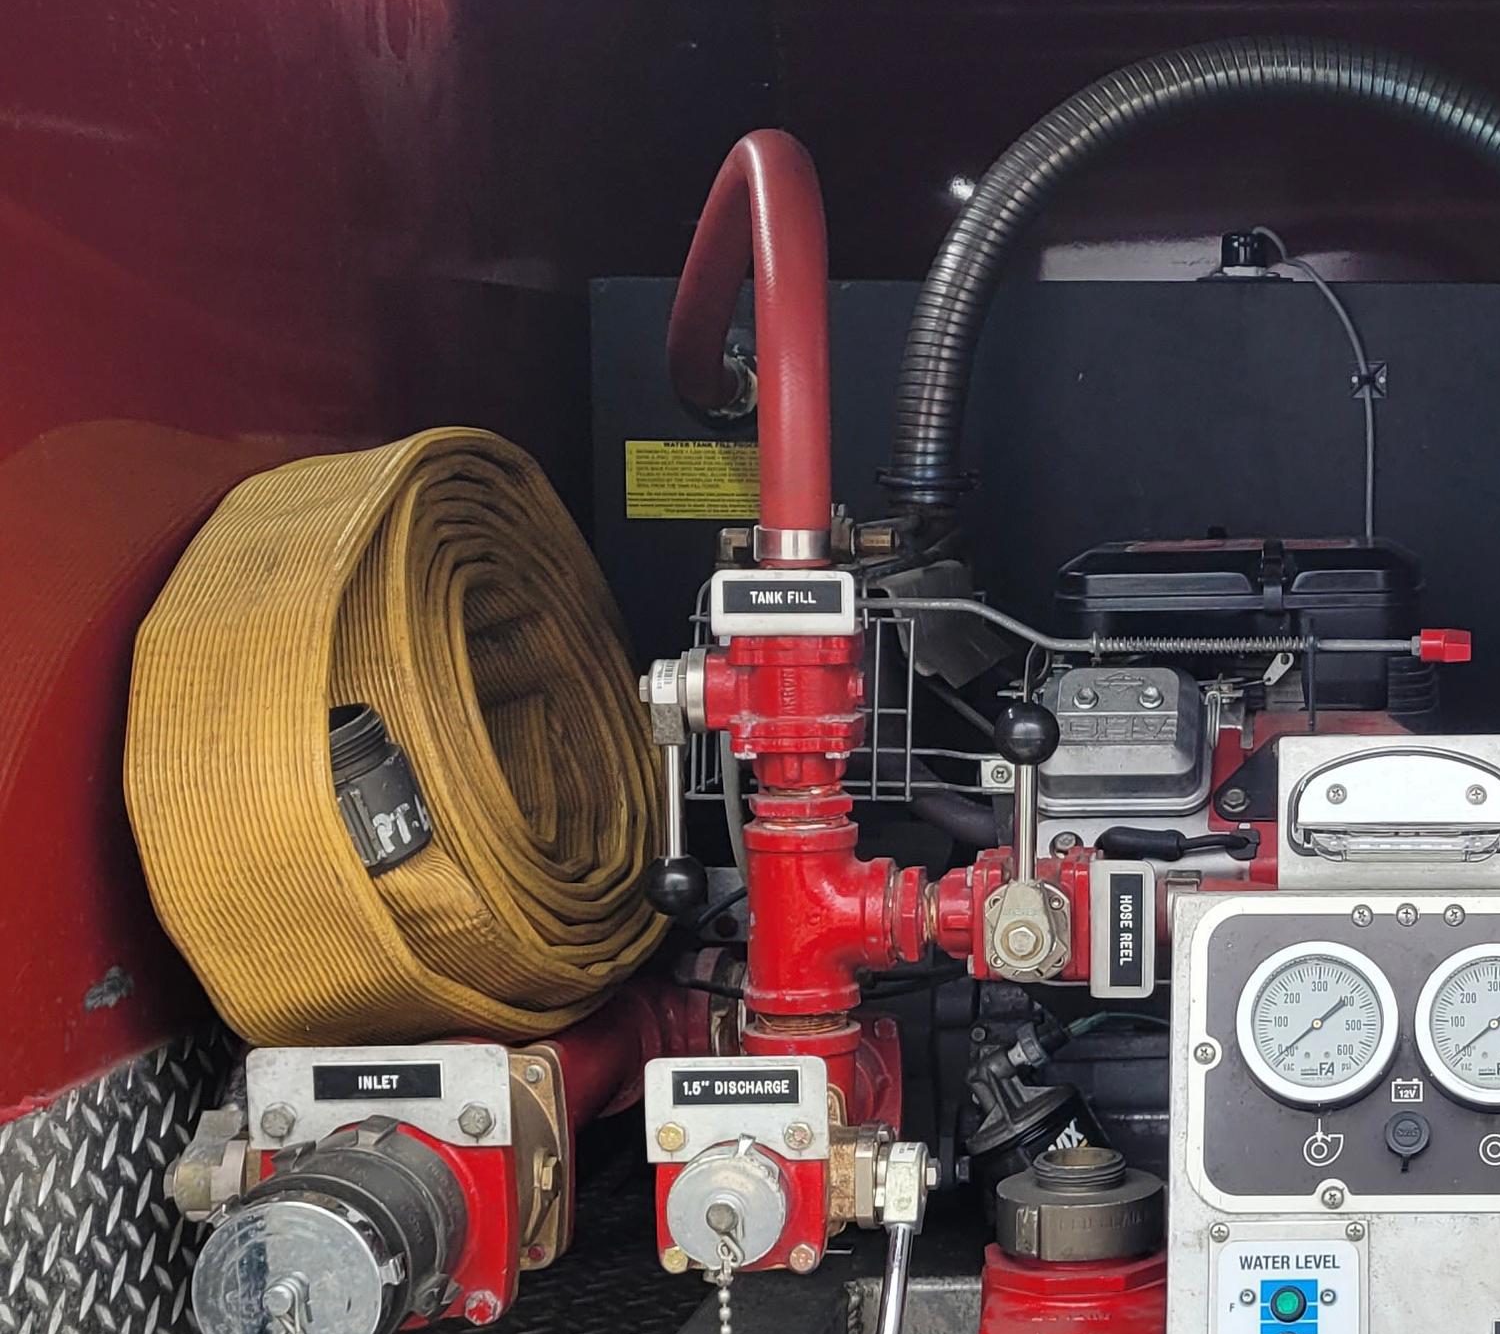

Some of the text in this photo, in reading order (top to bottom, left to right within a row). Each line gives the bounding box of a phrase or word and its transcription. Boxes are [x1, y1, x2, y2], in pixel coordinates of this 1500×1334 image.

[749, 591, 817, 604] TANK FILL
[1119, 895, 1133, 966] HOSE REEL
[1311, 981, 1328, 992] 300
[1284, 993, 1301, 1004] 200
[1460, 992, 1477, 1004] 200
[1273, 1016, 1289, 1027] 100
[1345, 1020, 1362, 1031] 500
[1450, 1016, 1465, 1027] 100
[1337, 1044, 1354, 1056] 600
[1319, 1062, 1335, 1076] FA
[1341, 1063, 1352, 1072] psi
[358, 1075, 399, 1090] INLET
[714, 1079, 790, 1095] DISCHARGE
[1399, 1089, 1416, 1098] 12V
[1239, 1254, 1341, 1270] WATER LEVEL
[1229, 1302, 1235, 1312] F
